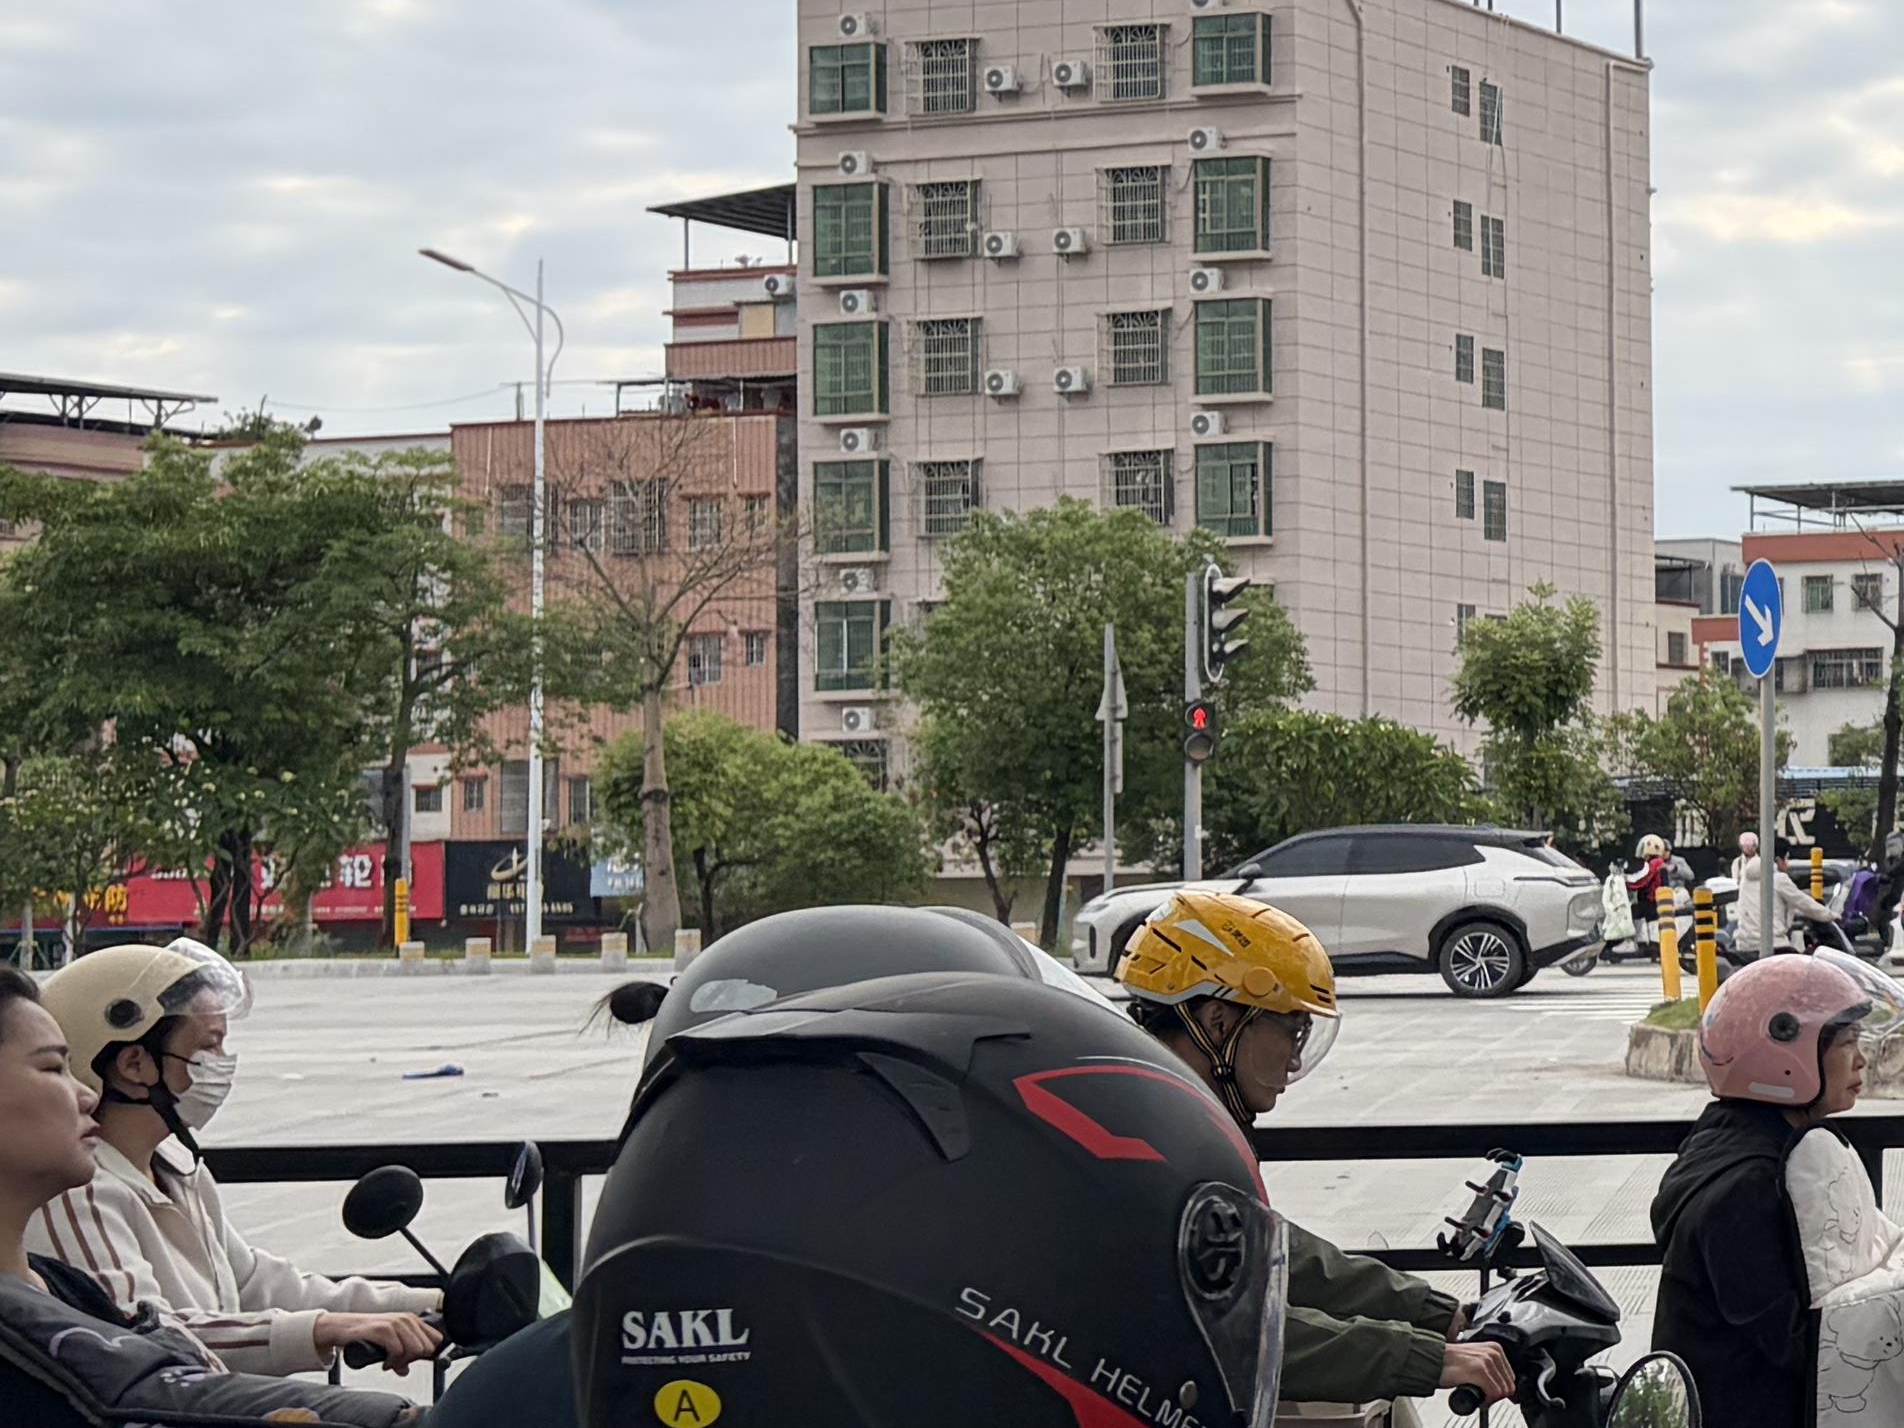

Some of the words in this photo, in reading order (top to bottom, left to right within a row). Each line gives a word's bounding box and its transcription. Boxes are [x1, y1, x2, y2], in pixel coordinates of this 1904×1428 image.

[622, 1308, 750, 1350] SAKL
[955, 1287, 1071, 1369] SAKL
[709, 1351, 751, 1363] SAFETY
[673, 1389, 701, 1422] A
